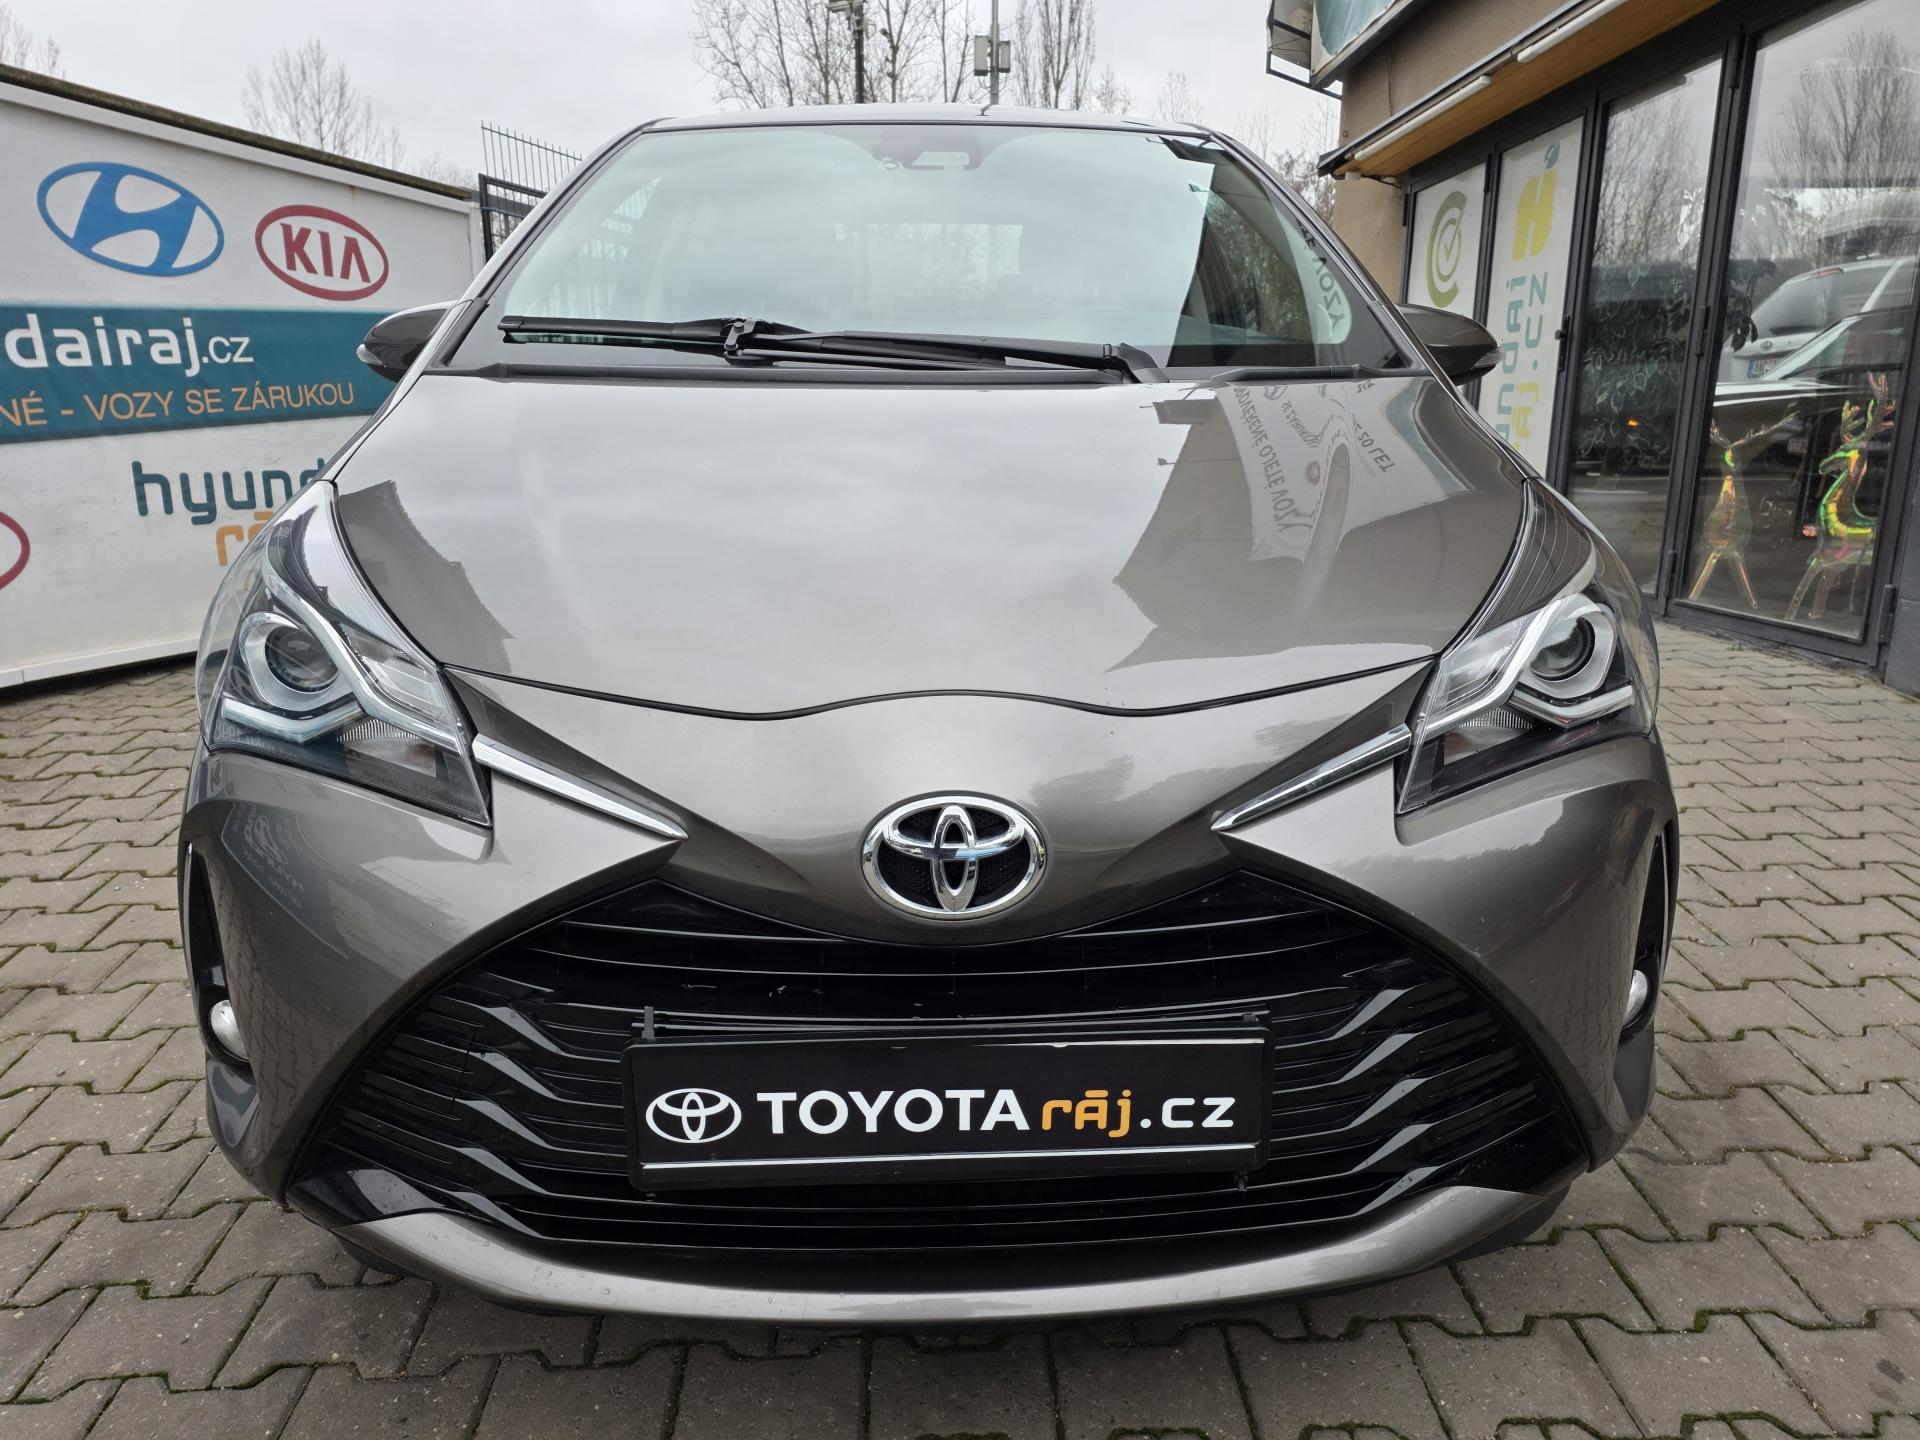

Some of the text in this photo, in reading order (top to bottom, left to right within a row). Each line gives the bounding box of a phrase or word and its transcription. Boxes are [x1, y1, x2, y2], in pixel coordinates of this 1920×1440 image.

[279, 222, 371, 284] KIA
[83, 388, 175, 422] VOZY
[185, 387, 224, 415] SE
[231, 379, 355, 412] ZÁRUKOU
[757, 1088, 1030, 1134] TOYOTA
